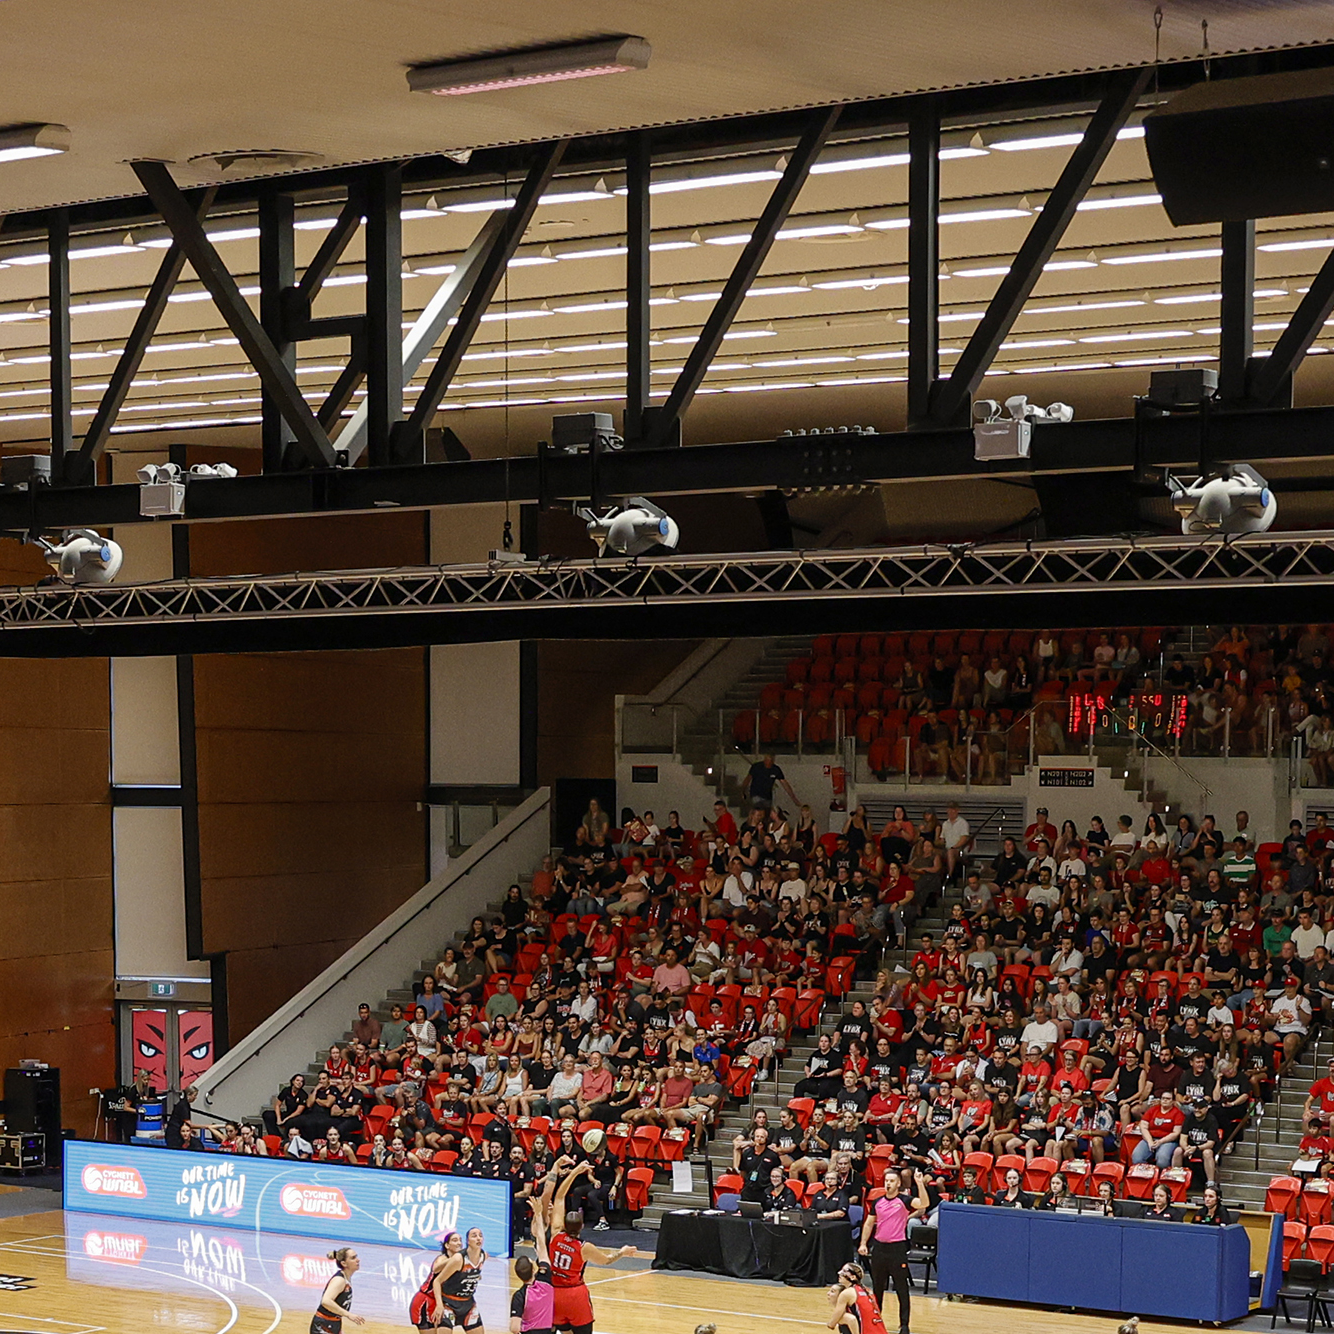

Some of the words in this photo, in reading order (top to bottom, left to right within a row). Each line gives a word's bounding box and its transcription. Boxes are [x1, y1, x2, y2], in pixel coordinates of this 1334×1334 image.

[842, 1024, 861, 1034] LYNX
[103, 1170, 135, 1180] CYGNETT
[182, 1165, 204, 1185] OUR
[206, 1161, 235, 1181] TIME
[102, 1179, 143, 1194] WNBL
[176, 1187, 189, 1205] IS
[190, 1174, 246, 1218] NOW
[303, 1189, 338, 1202] CYGNETT
[390, 1187, 416, 1206] OUR
[418, 1182, 448, 1204] TIME
[302, 1198, 346, 1216] WNBL
[383, 1209, 398, 1227] IS
[398, 1195, 460, 1241] NOW
[553, 1250, 572, 1270] 10
